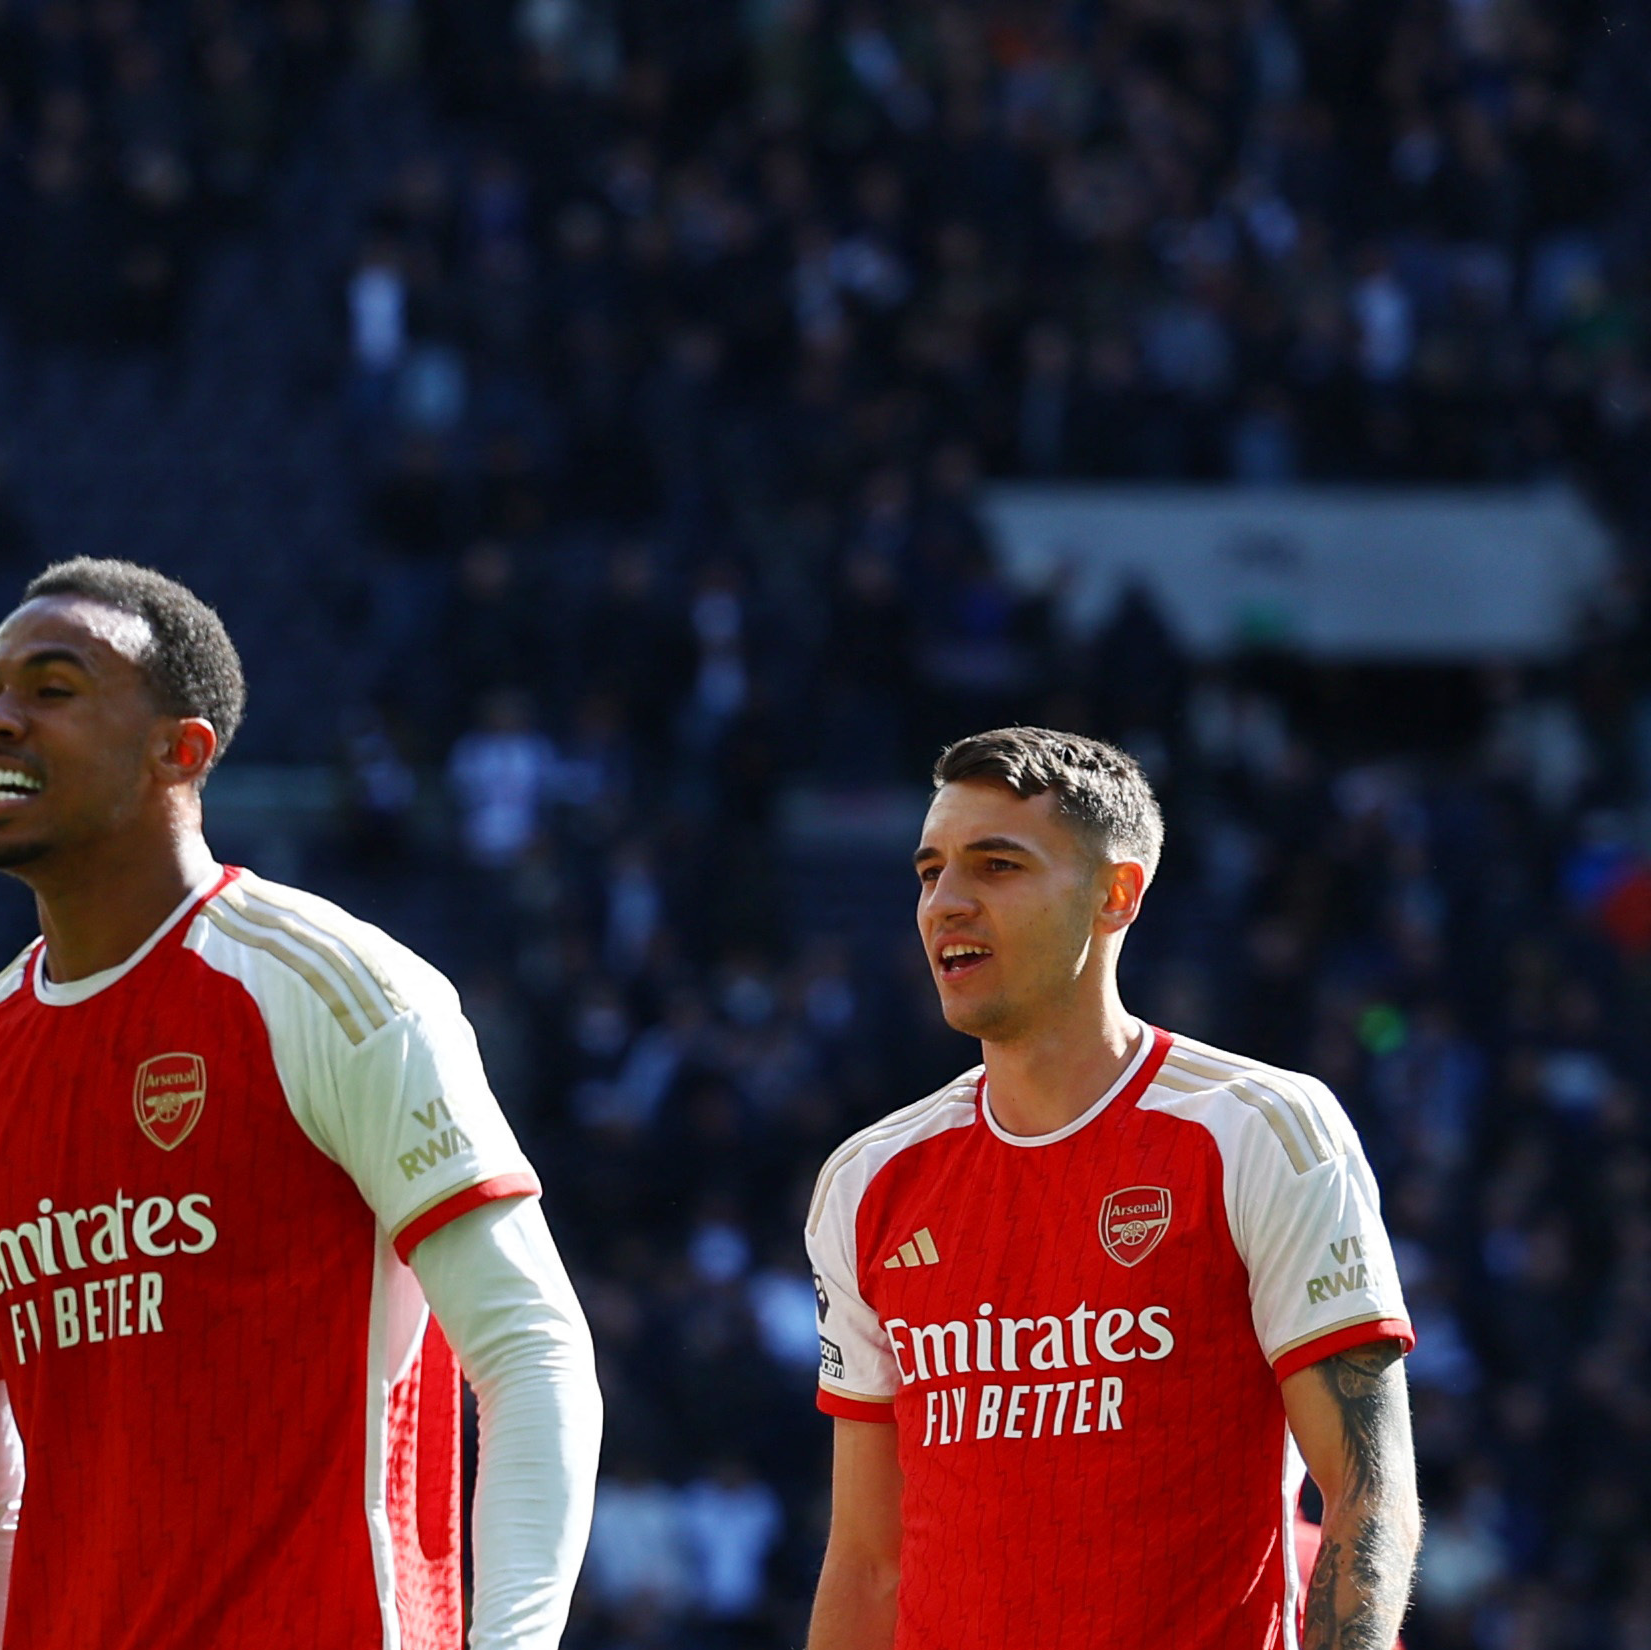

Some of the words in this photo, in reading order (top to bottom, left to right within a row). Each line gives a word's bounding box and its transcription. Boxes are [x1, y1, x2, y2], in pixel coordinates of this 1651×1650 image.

[1111, 1199, 1162, 1217] Arsenal
[884, 1302, 1175, 1386] Emirates
[923, 1388, 965, 1446] FLY
[976, 1376, 1123, 1440] BETTER
